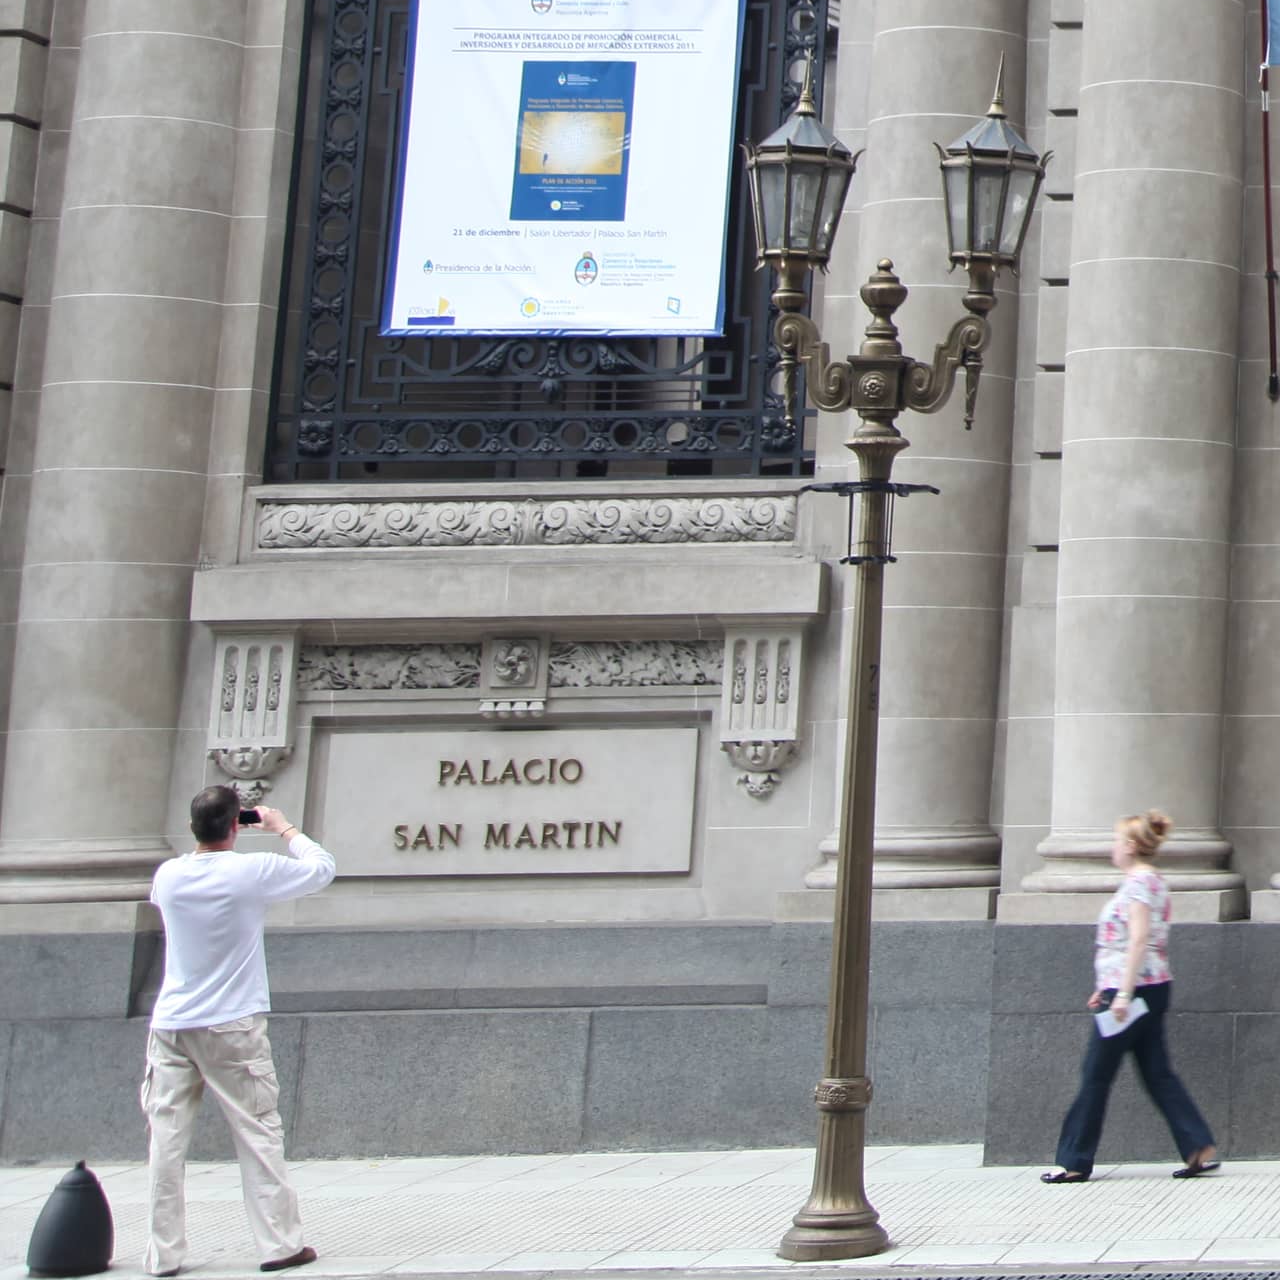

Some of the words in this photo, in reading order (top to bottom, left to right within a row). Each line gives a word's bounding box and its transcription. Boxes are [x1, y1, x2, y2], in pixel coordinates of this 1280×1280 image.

[473, 32, 521, 40] PROGRAMA
[571, 33, 581, 41] DE
[583, 32, 633, 41] PROMOCIÓN
[460, 41, 513, 49] INVERSIONES
[514, 41, 520, 49] Y
[521, 41, 574, 49] DESARROLLO
[633, 42, 674, 50] EXTERNOS
[676, 42, 695, 50] 2011
[452, 228, 463, 237] 21
[465, 228, 477, 237] de
[478, 228, 521, 237] diciembre
[435, 263, 481, 272] Presidencia
[483, 264, 493, 272] de
[495, 263, 502, 272] la
[437, 758, 584, 786] PALACIO
[394, 823, 463, 850] SAN
[483, 821, 623, 849] MARTIN
